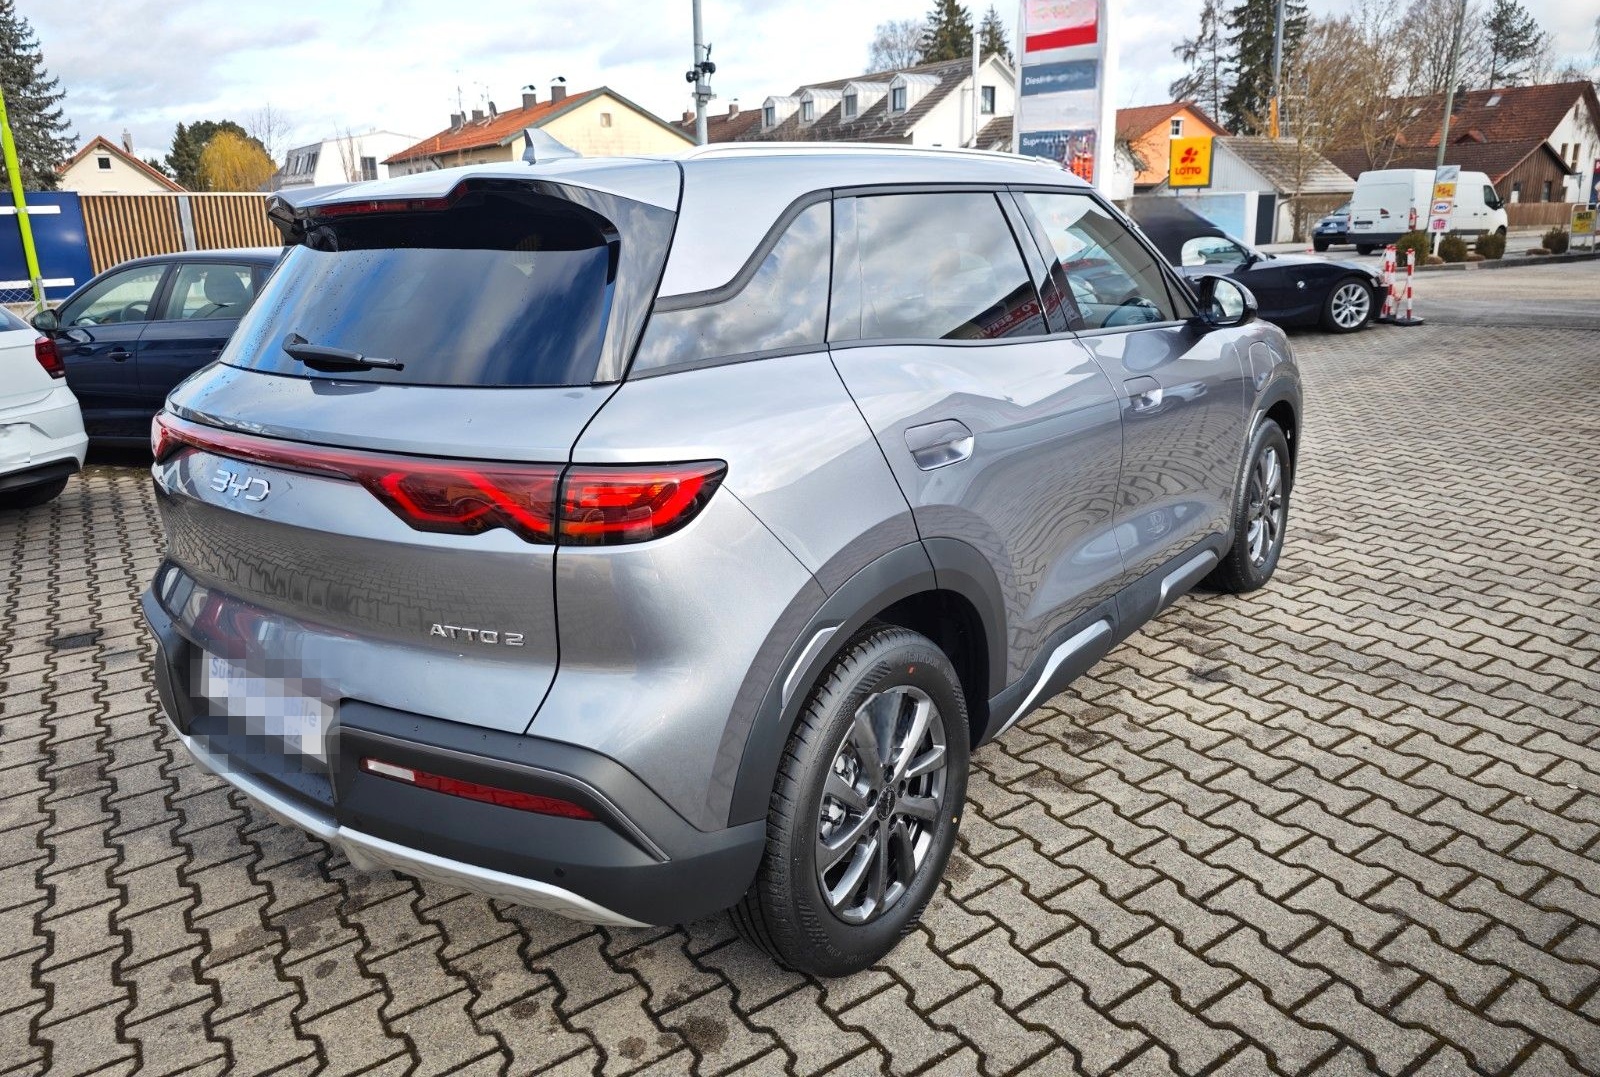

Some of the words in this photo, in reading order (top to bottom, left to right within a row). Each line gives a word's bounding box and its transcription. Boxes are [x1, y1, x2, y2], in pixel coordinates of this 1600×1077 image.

[1175, 166, 1201, 175] LOTTO
[210, 469, 270, 502] BYD
[430, 623, 498, 644] ATTO
[505, 632, 524, 646] 2
